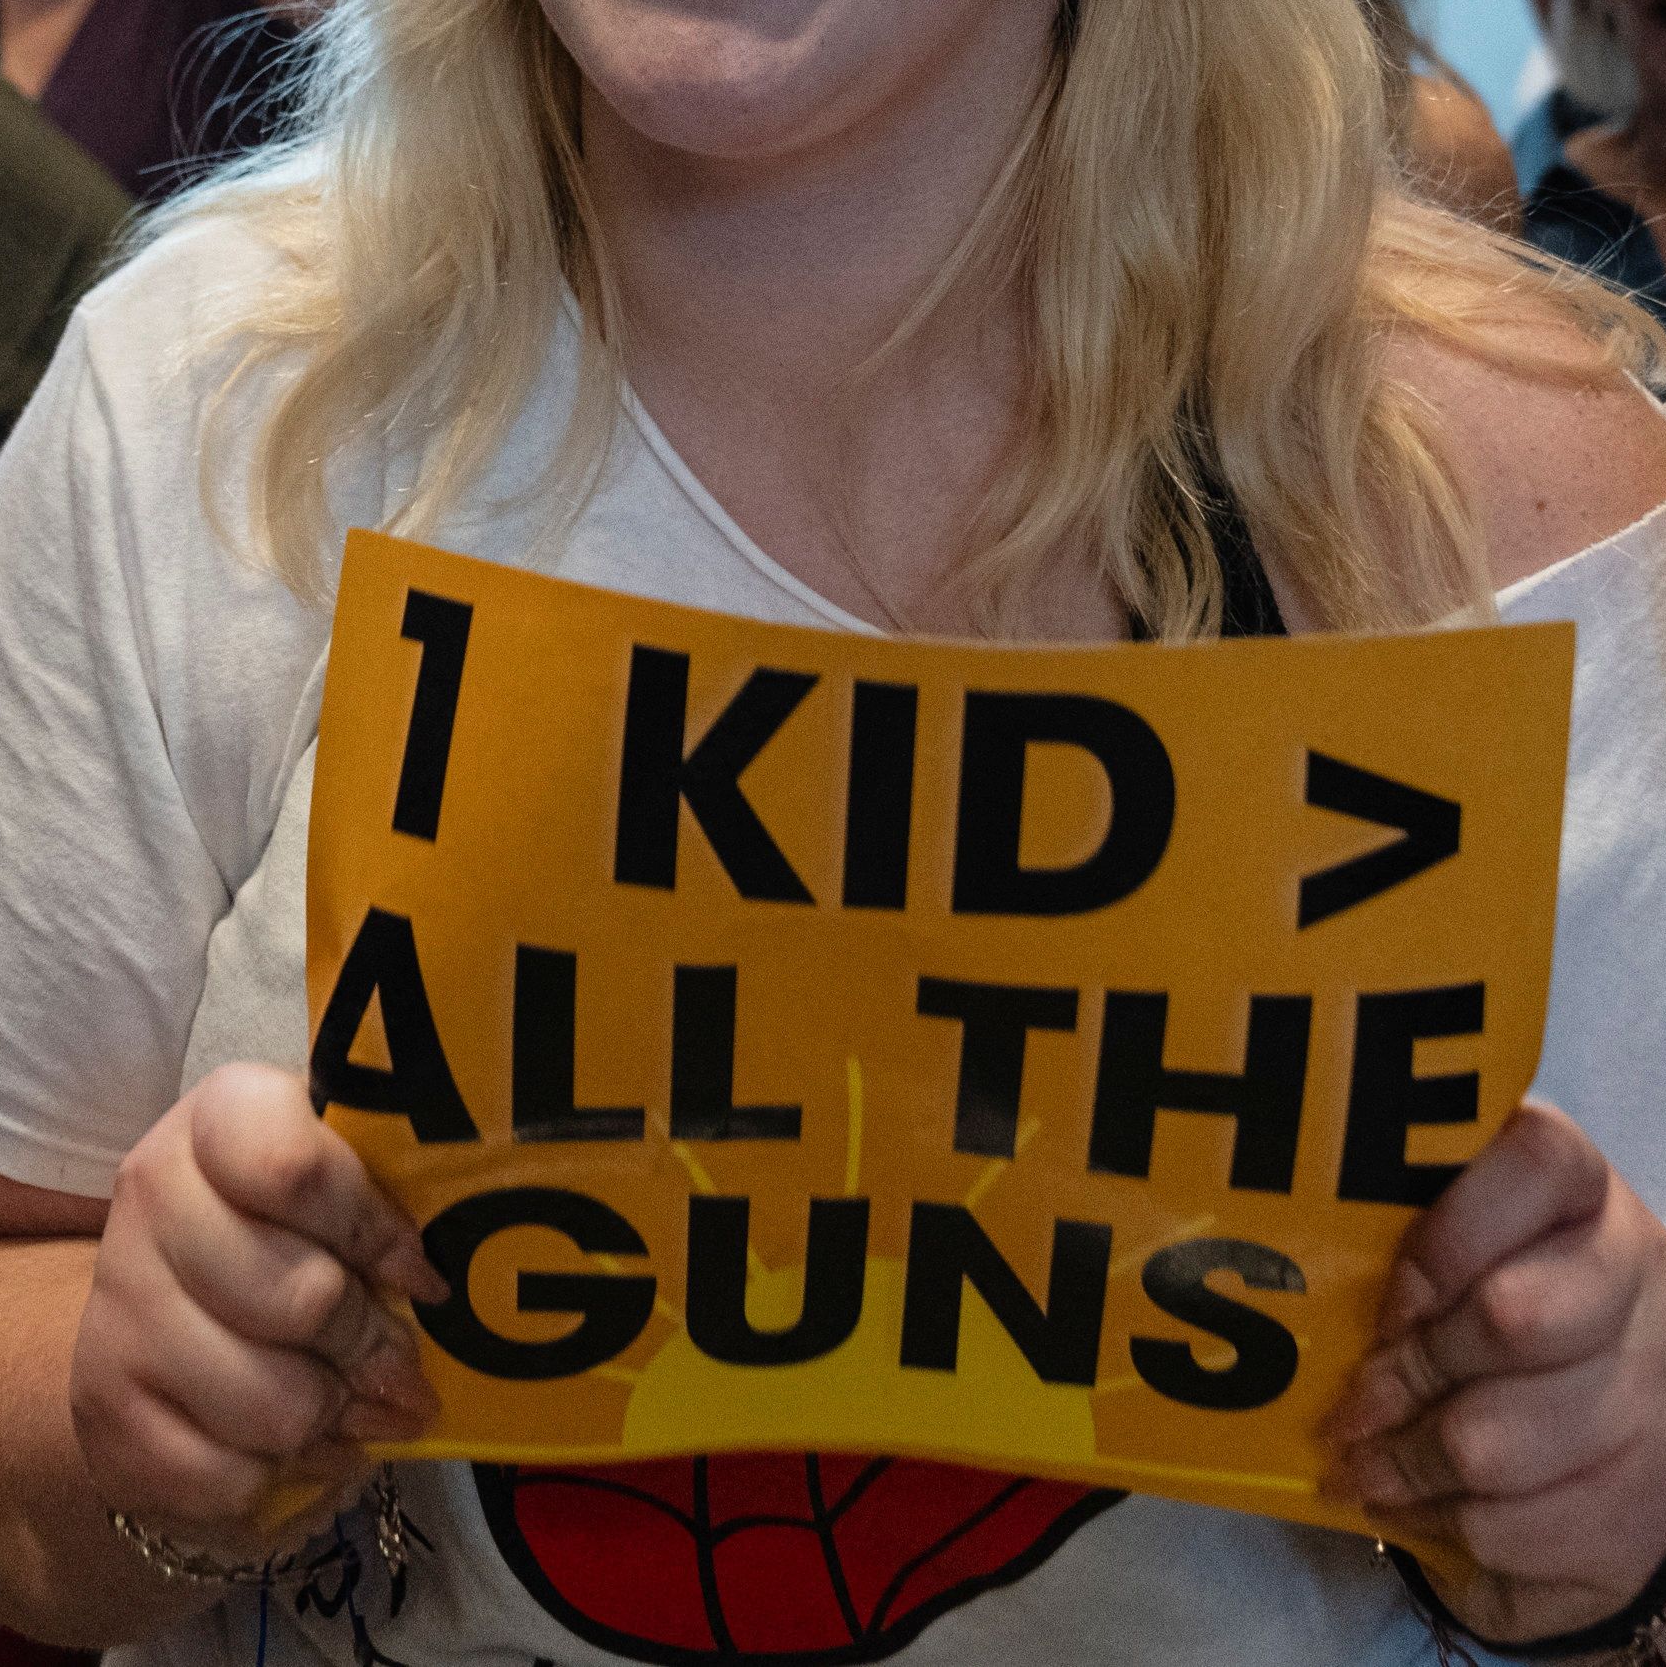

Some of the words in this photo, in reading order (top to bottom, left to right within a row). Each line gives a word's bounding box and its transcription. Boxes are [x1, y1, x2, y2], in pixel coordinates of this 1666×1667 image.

[391, 586, 475, 845] 1
[612, 642, 1177, 919] KID
[309, 902, 803, 1146] ALL
[914, 972, 1486, 1210] THE
[410, 1183, 1310, 1412] GUNS
